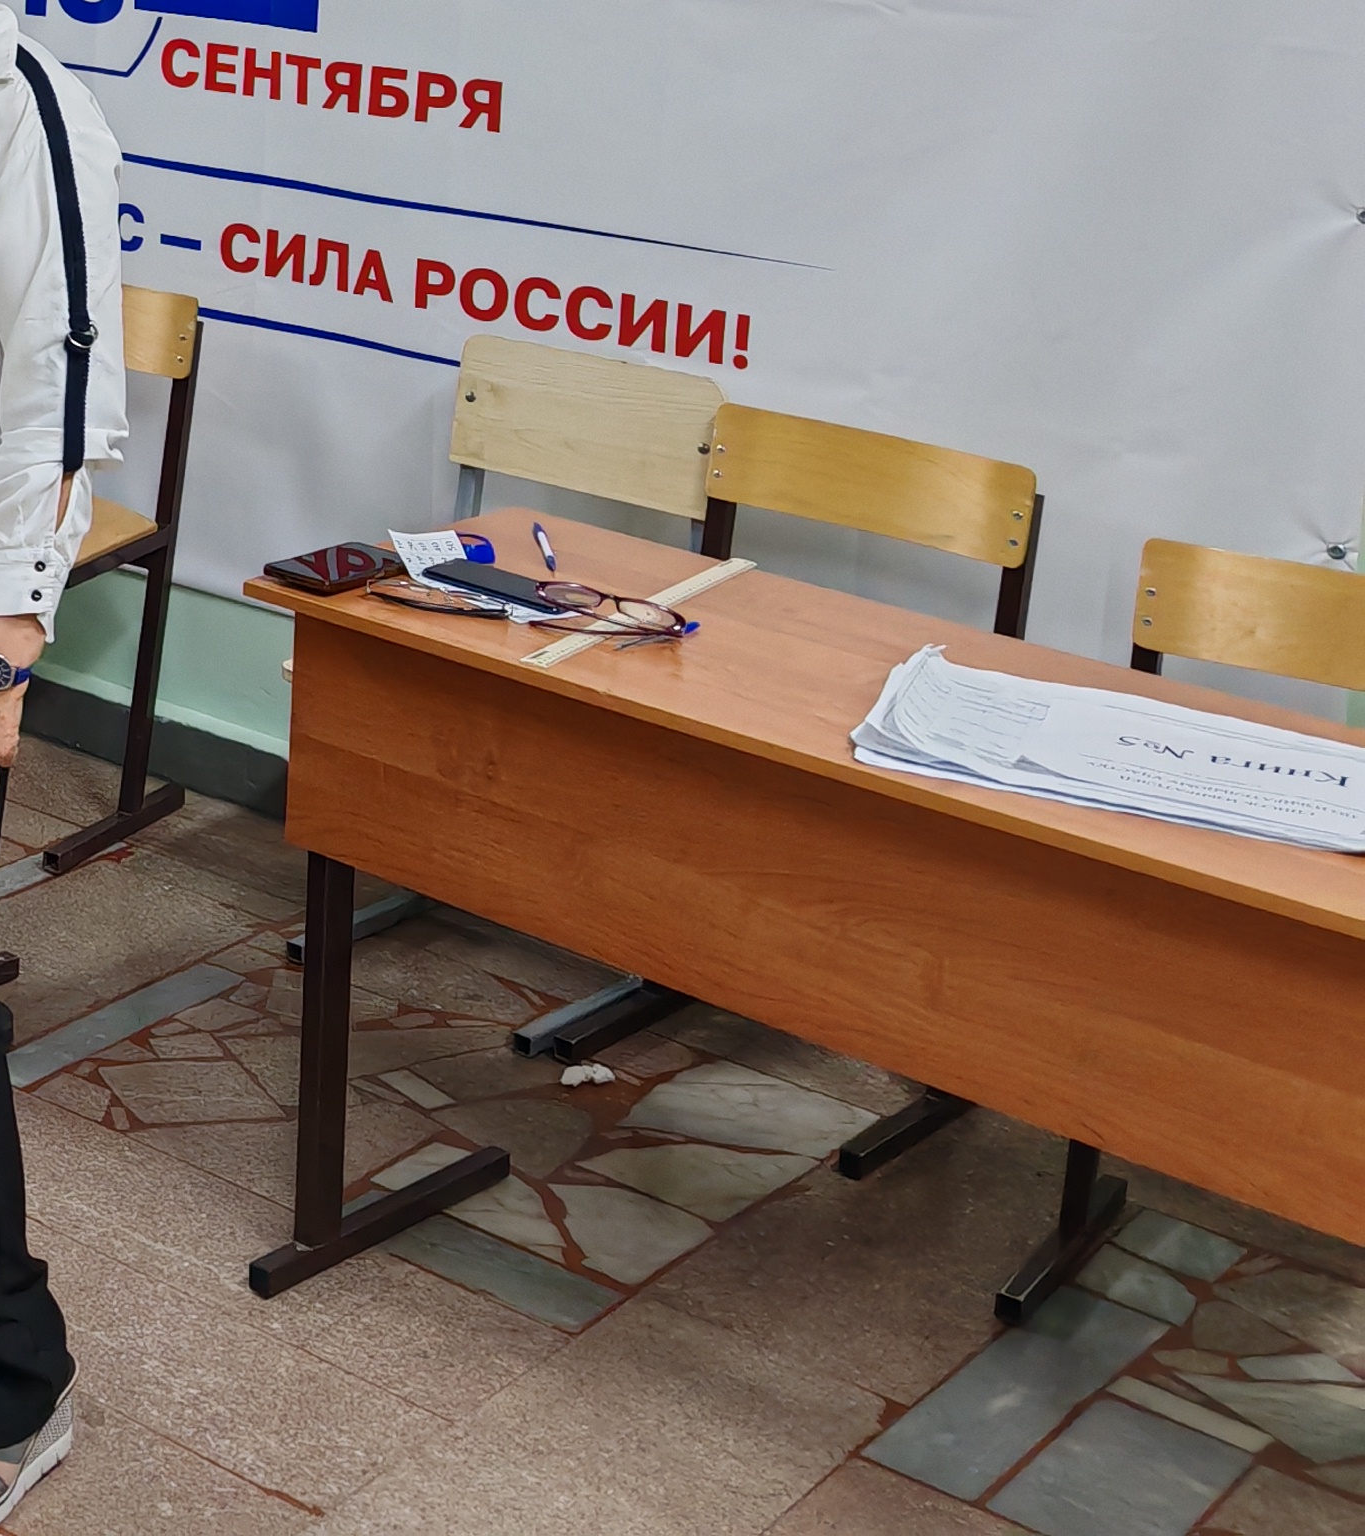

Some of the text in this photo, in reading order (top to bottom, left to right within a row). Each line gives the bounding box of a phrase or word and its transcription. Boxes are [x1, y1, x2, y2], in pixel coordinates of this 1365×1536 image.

[161, 39, 502, 132] СЕНТЯБРЯ
[220, 224, 392, 302] СИЛА
[415, 259, 750, 369] РОССИИ!
[1211, 755, 1350, 787] Книга
